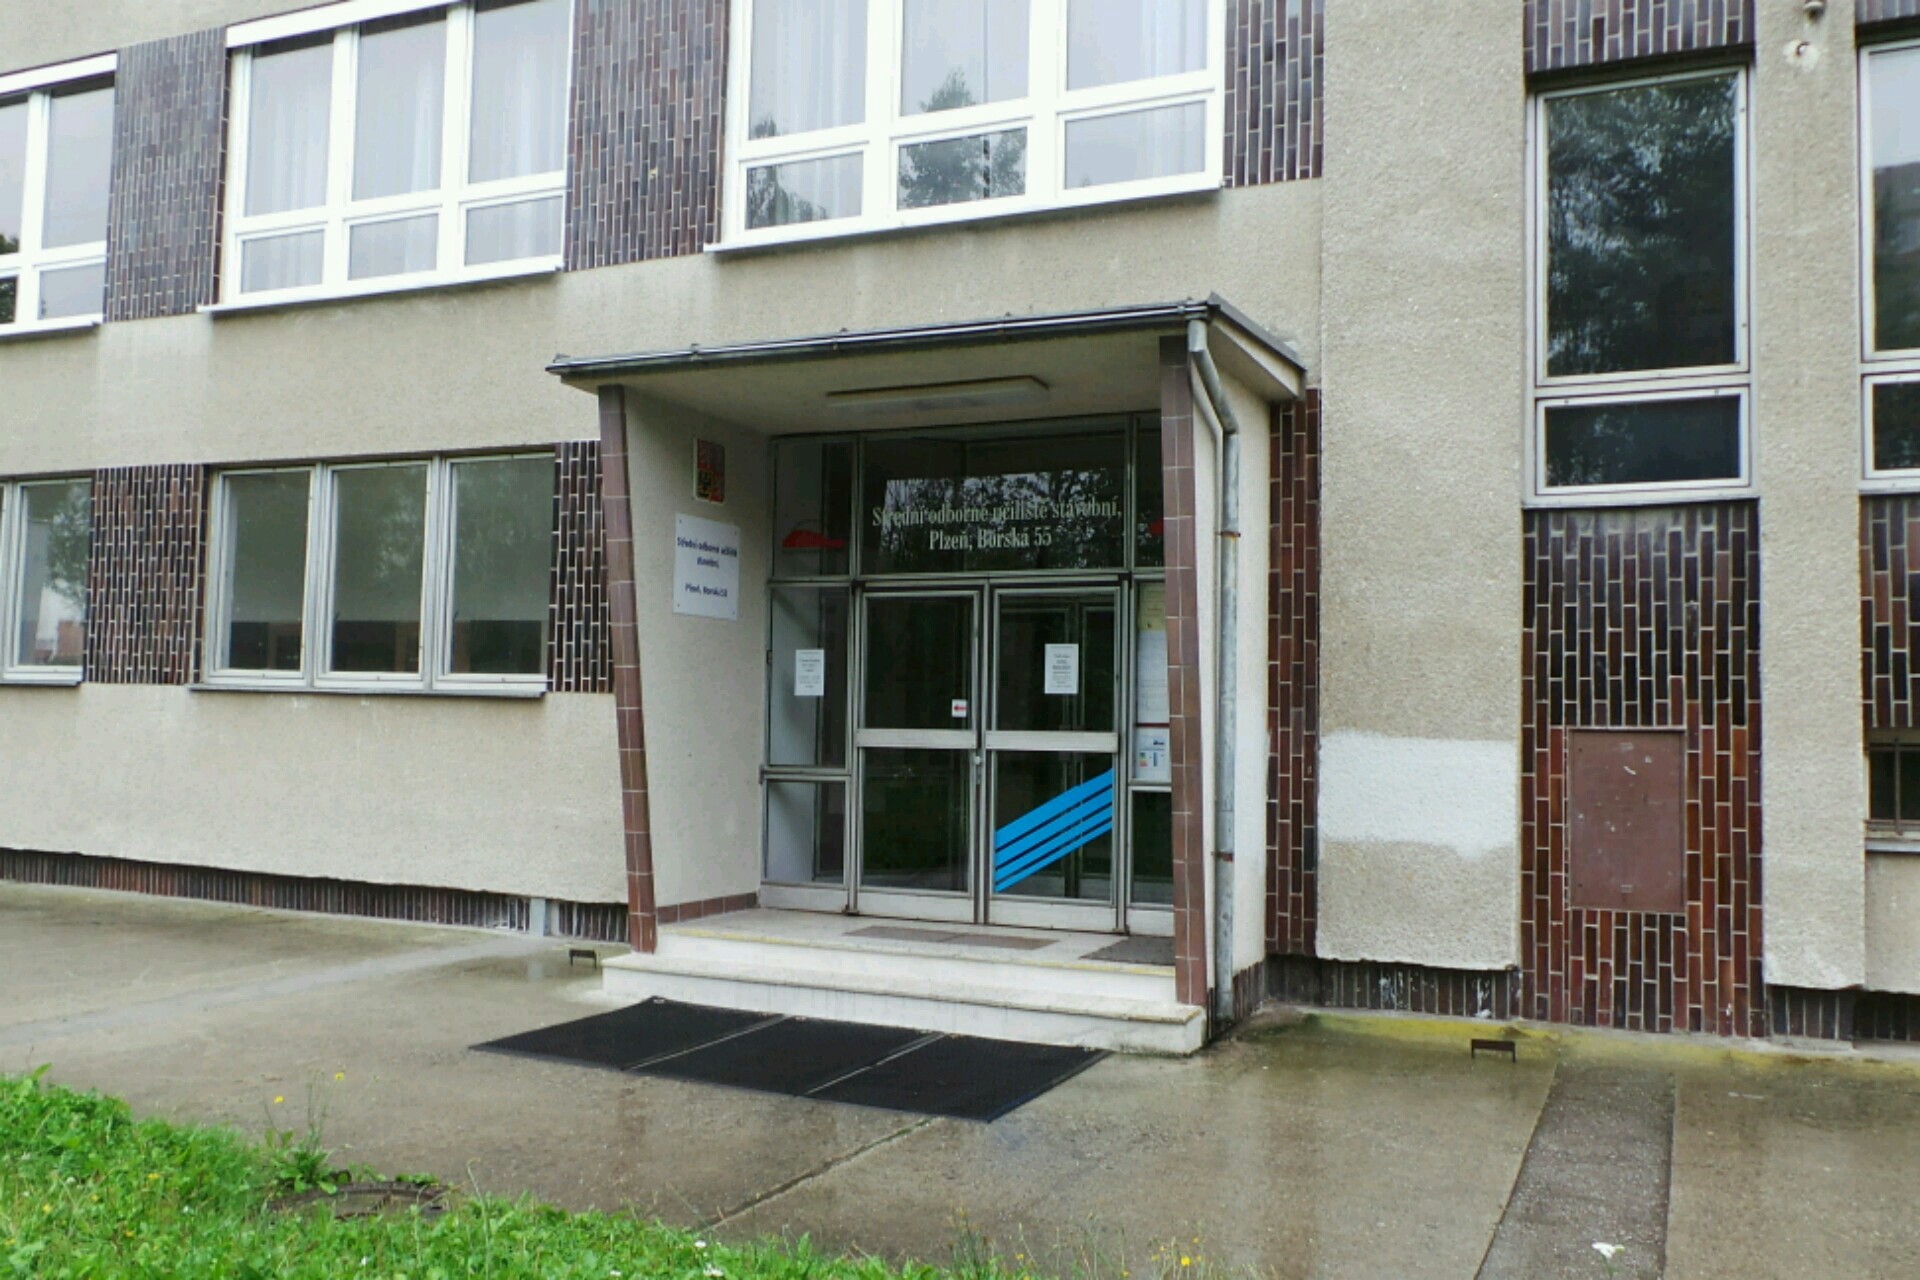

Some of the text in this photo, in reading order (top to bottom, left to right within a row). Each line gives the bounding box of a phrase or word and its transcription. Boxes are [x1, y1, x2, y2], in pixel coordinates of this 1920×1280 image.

[929, 526, 1052, 551] Plzeň, Borská 55
